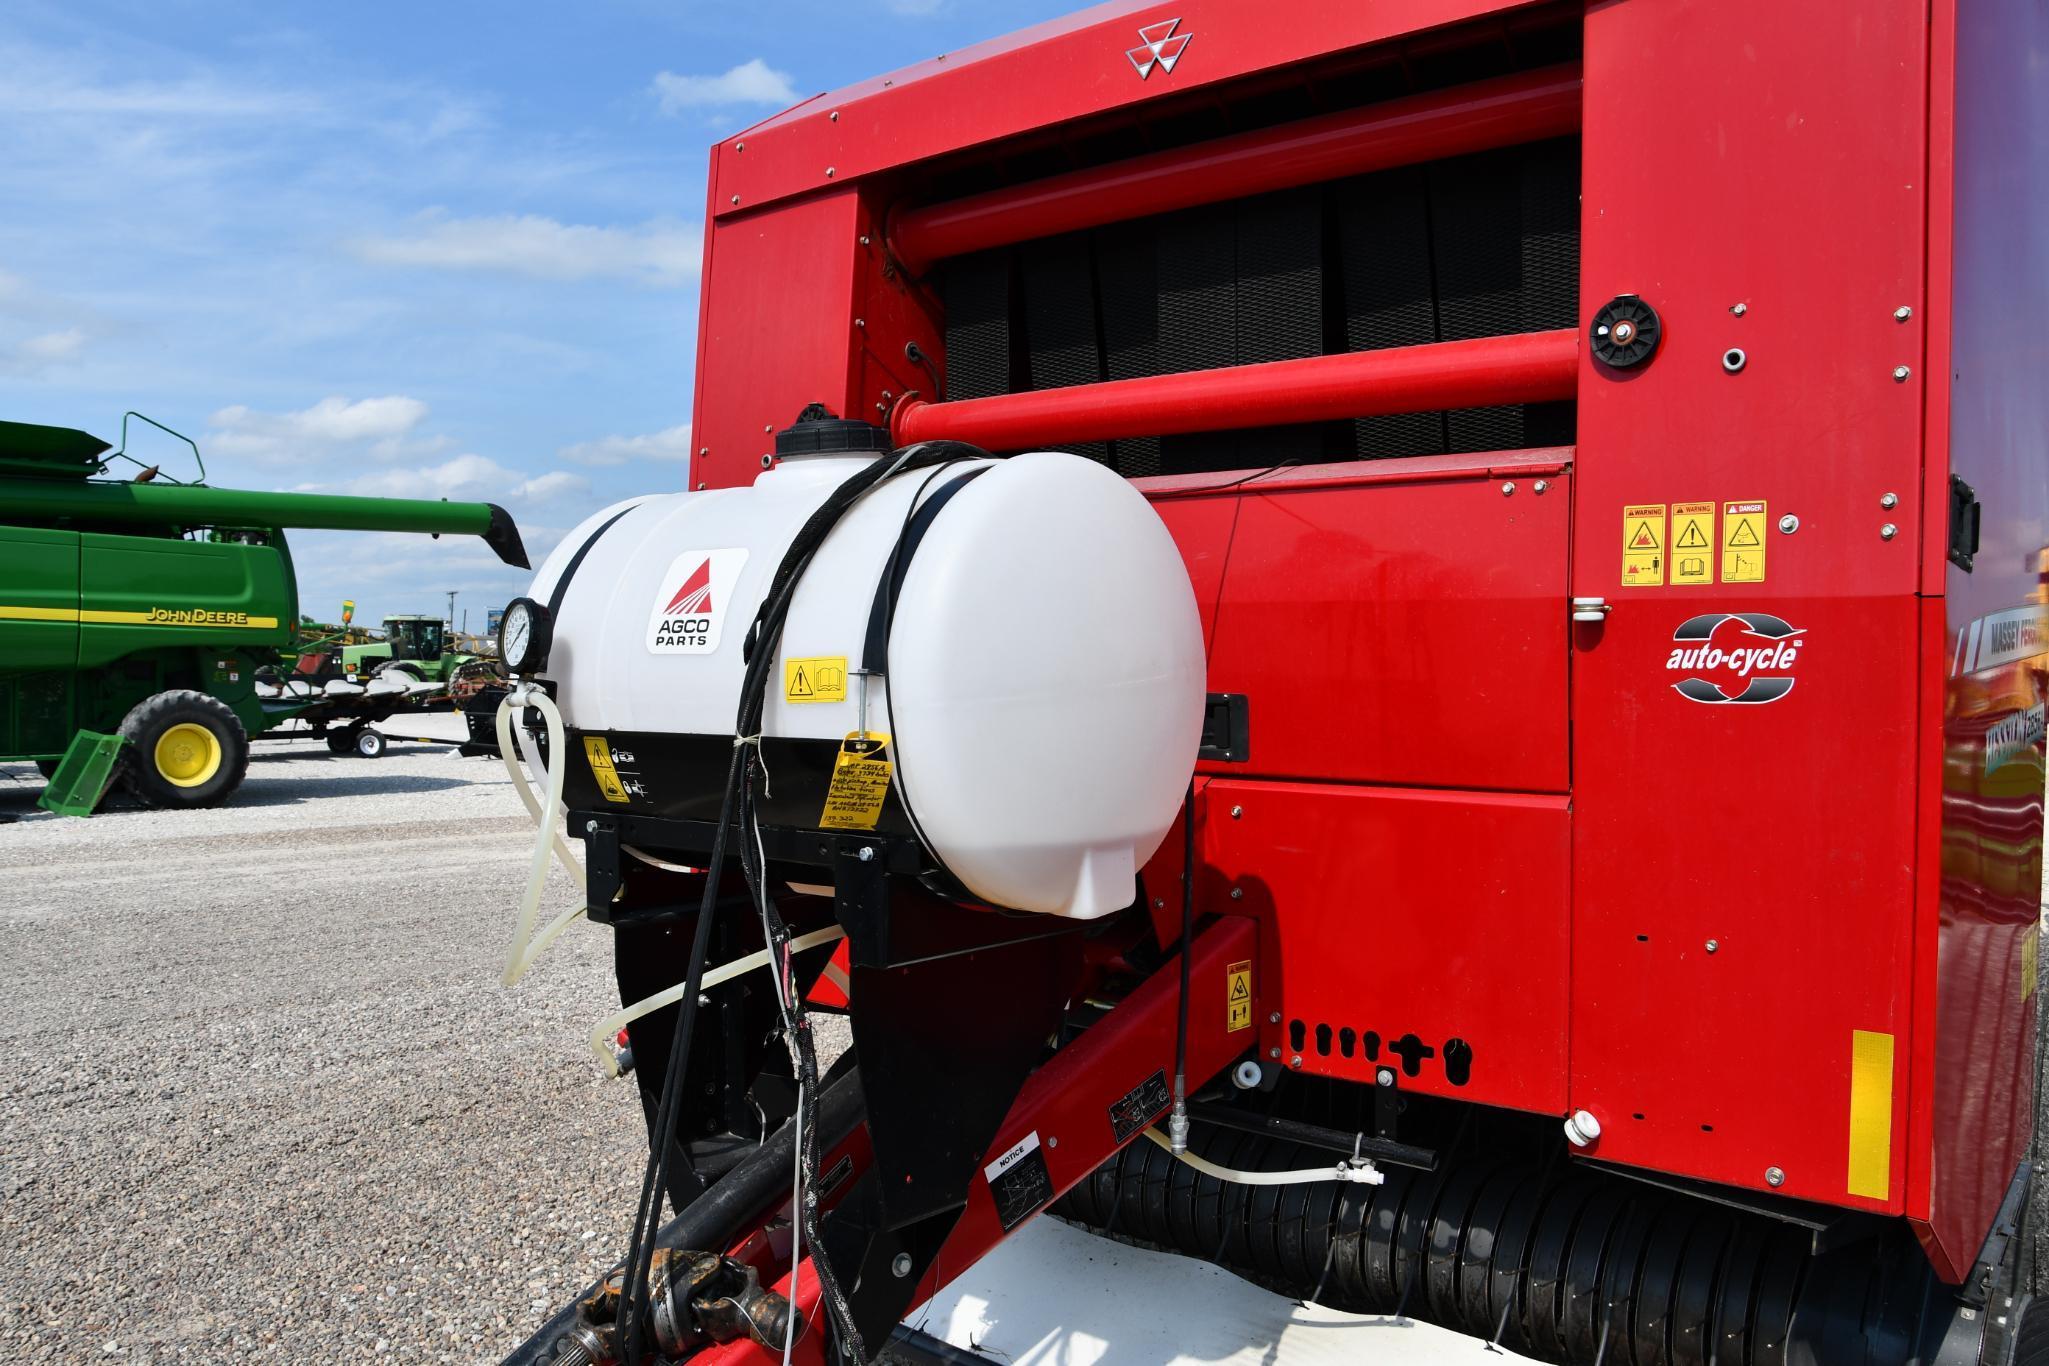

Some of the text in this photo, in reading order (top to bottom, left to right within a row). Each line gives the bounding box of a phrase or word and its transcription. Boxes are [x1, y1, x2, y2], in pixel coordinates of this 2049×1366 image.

[1635, 508, 1662, 517] WARNING
[1685, 505, 1711, 513] WARNING
[1738, 504, 1762, 512] DANGER
[147, 607, 248, 624] JOHN DEERE
[658, 619, 710, 634] AGCO
[655, 635, 707, 646] PARTS
[1991, 623, 2020, 655] MASSEY
[1665, 641, 1797, 677] auto-cycle
[1000, 1146, 1025, 1167] NOTICE
